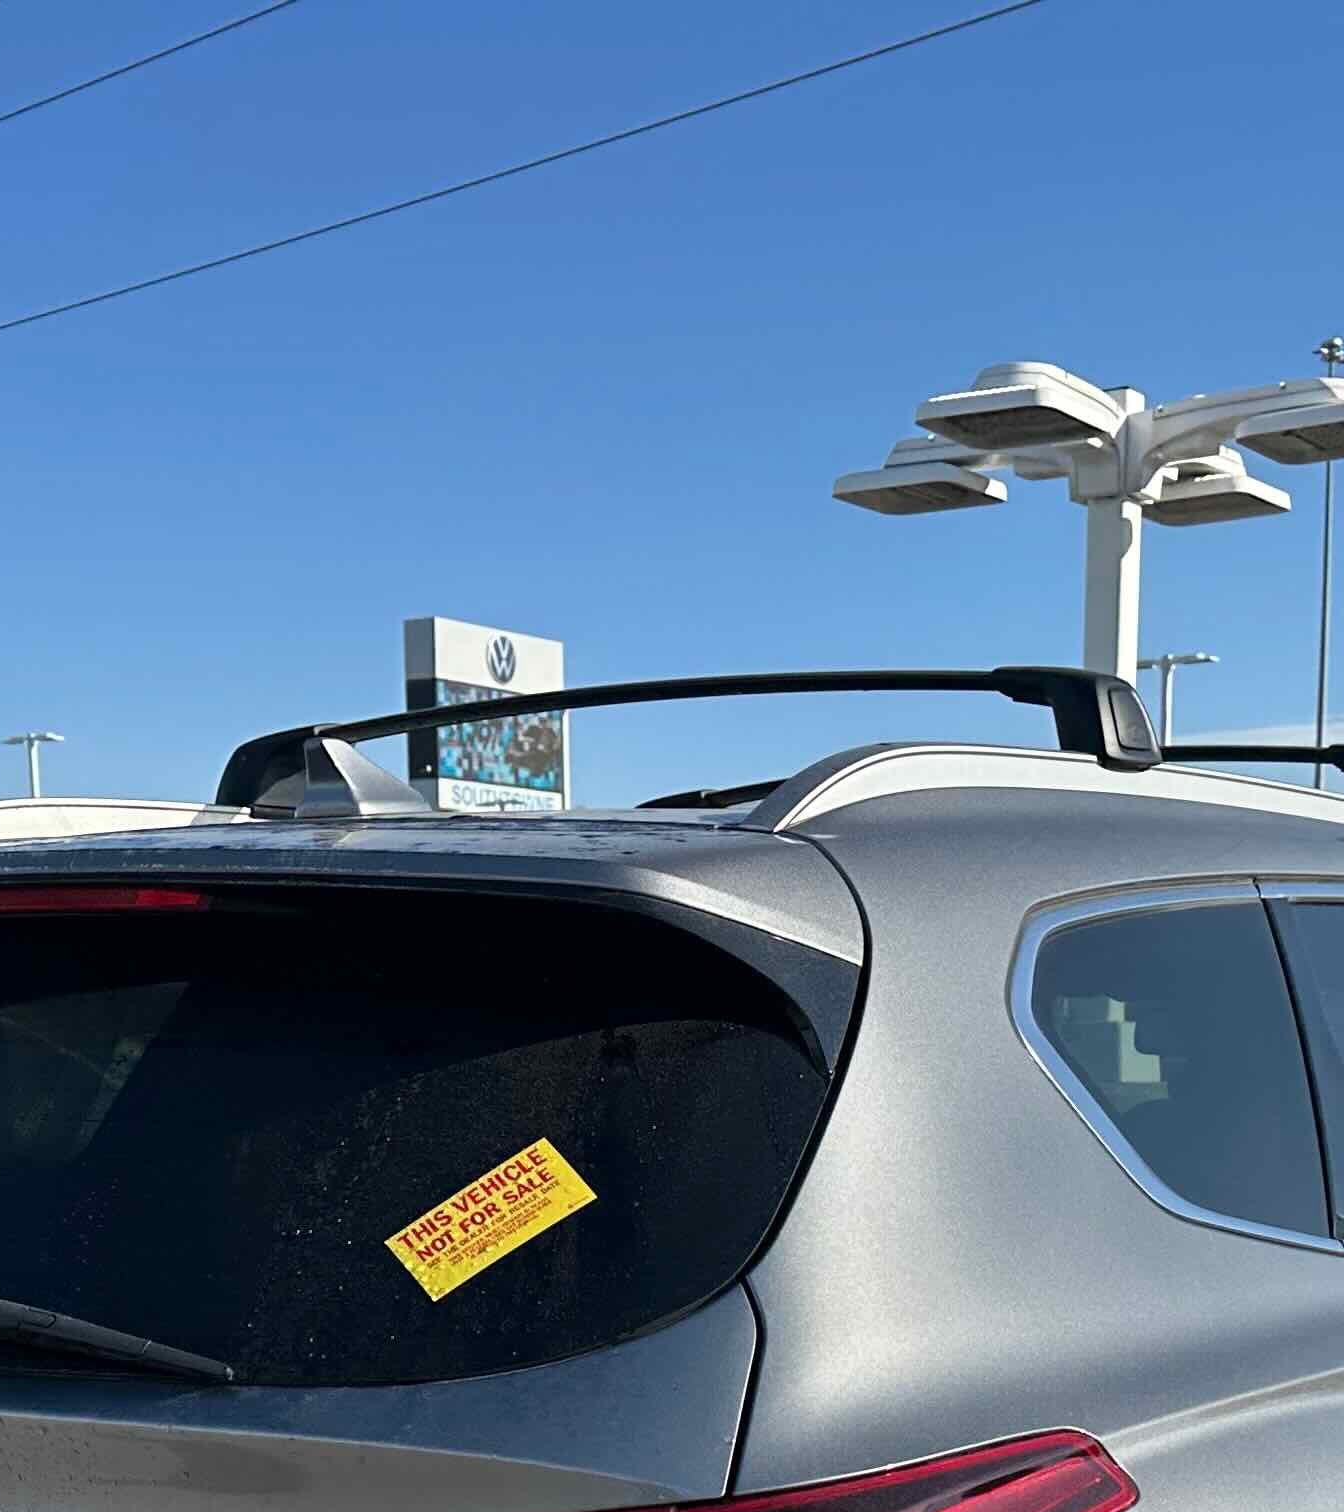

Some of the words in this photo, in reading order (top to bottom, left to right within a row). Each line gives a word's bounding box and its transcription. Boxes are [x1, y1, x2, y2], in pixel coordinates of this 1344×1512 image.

[396, 1209, 454, 1250] THIS
[450, 1147, 547, 1215] VEHICLE
[415, 1229, 456, 1262] NOT
[458, 1201, 501, 1234] FOR
[502, 1167, 555, 1205] SALE
